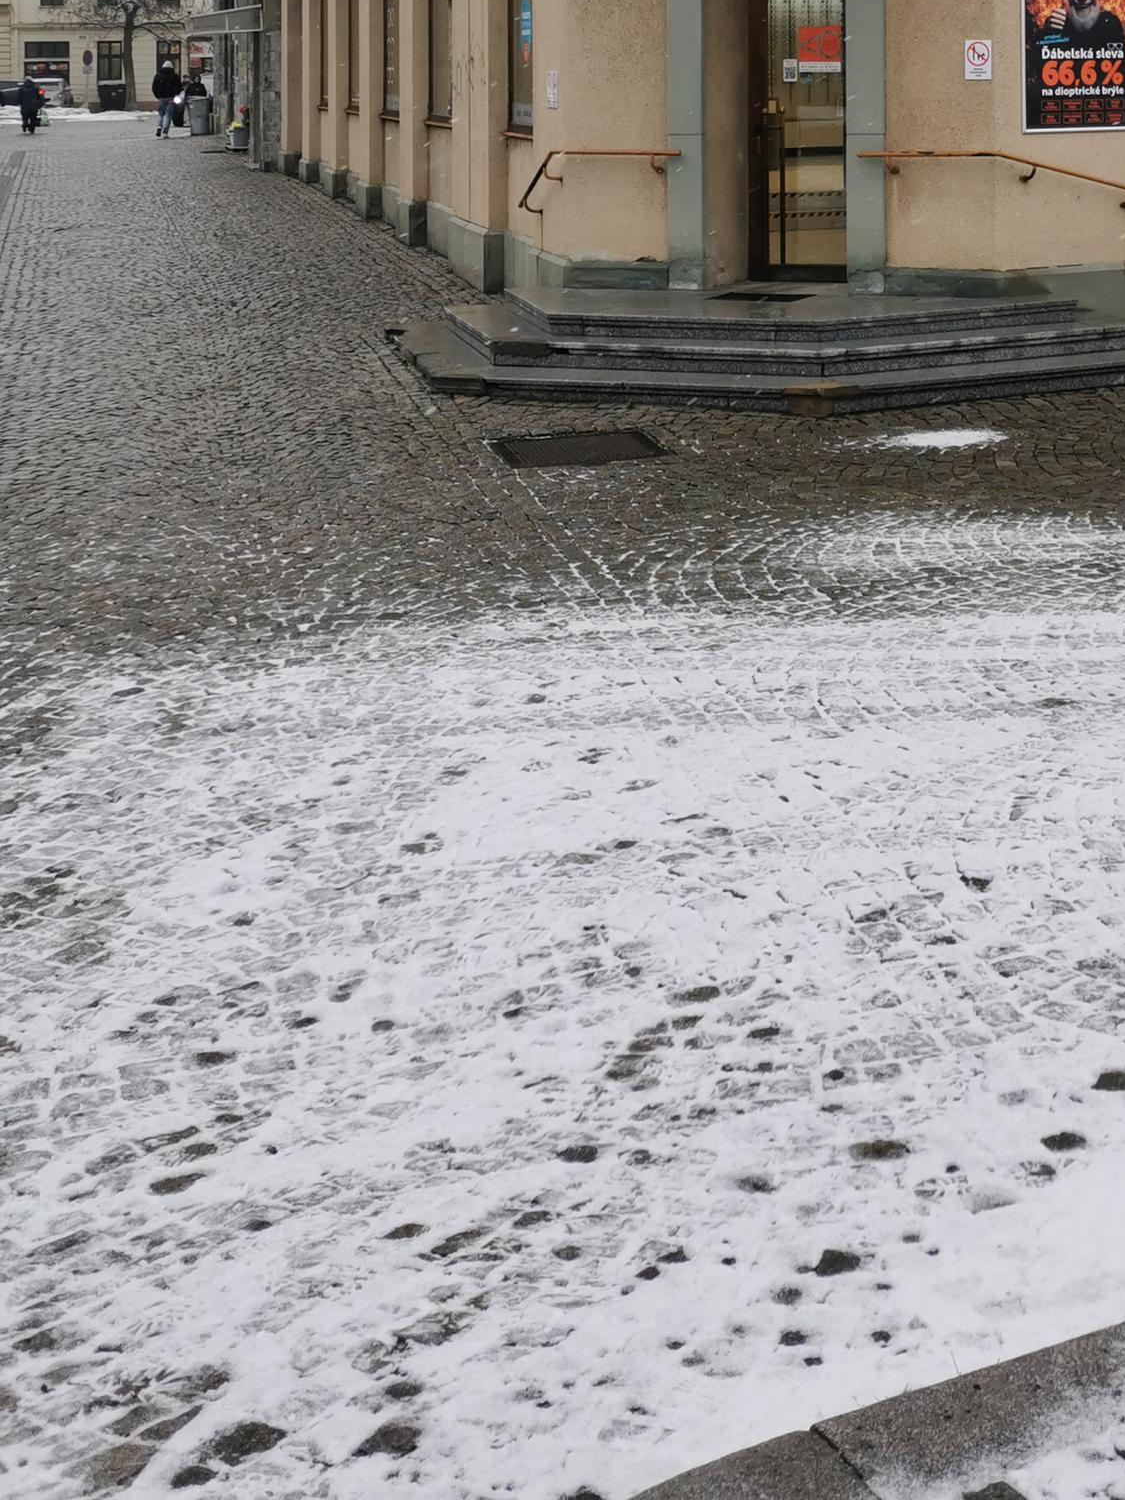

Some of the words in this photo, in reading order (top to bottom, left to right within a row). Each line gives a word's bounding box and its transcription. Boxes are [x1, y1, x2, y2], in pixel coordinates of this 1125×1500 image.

[1041, 45, 1094, 59] Ďábelská
[1095, 47, 1124, 59] sleva
[1041, 88, 1054, 96] na
[1055, 86, 1100, 98] dioptrické
[1101, 86, 1125, 97] brýle
